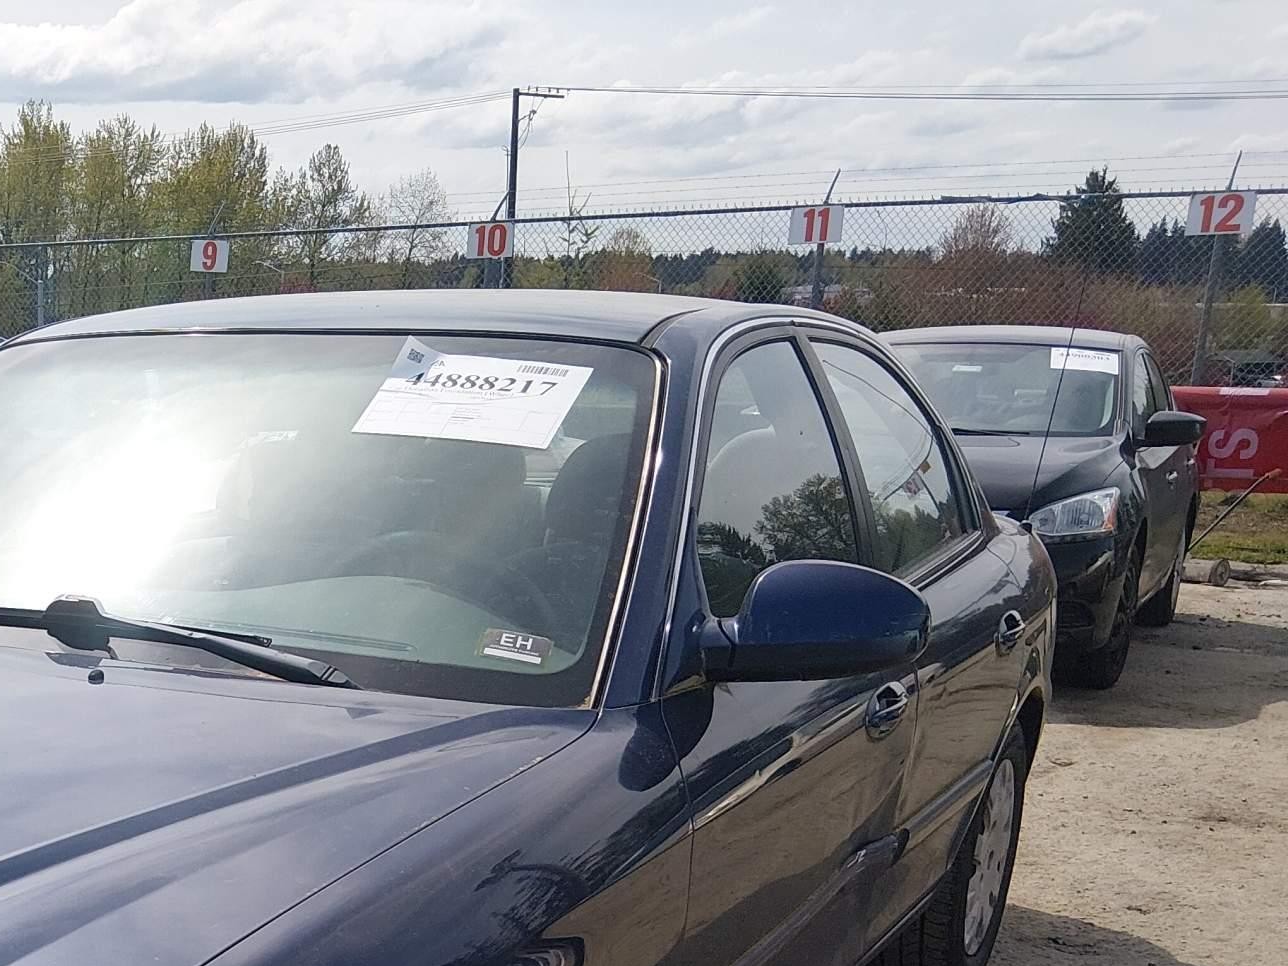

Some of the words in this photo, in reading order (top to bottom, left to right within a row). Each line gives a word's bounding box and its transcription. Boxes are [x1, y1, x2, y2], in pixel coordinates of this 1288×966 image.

[803, 207, 831, 242] 11
[1199, 193, 1245, 233] 12
[201, 240, 218, 271] 9
[475, 223, 508, 257] 10
[405, 372, 559, 397] 44888217
[499, 632, 534, 651] EH
